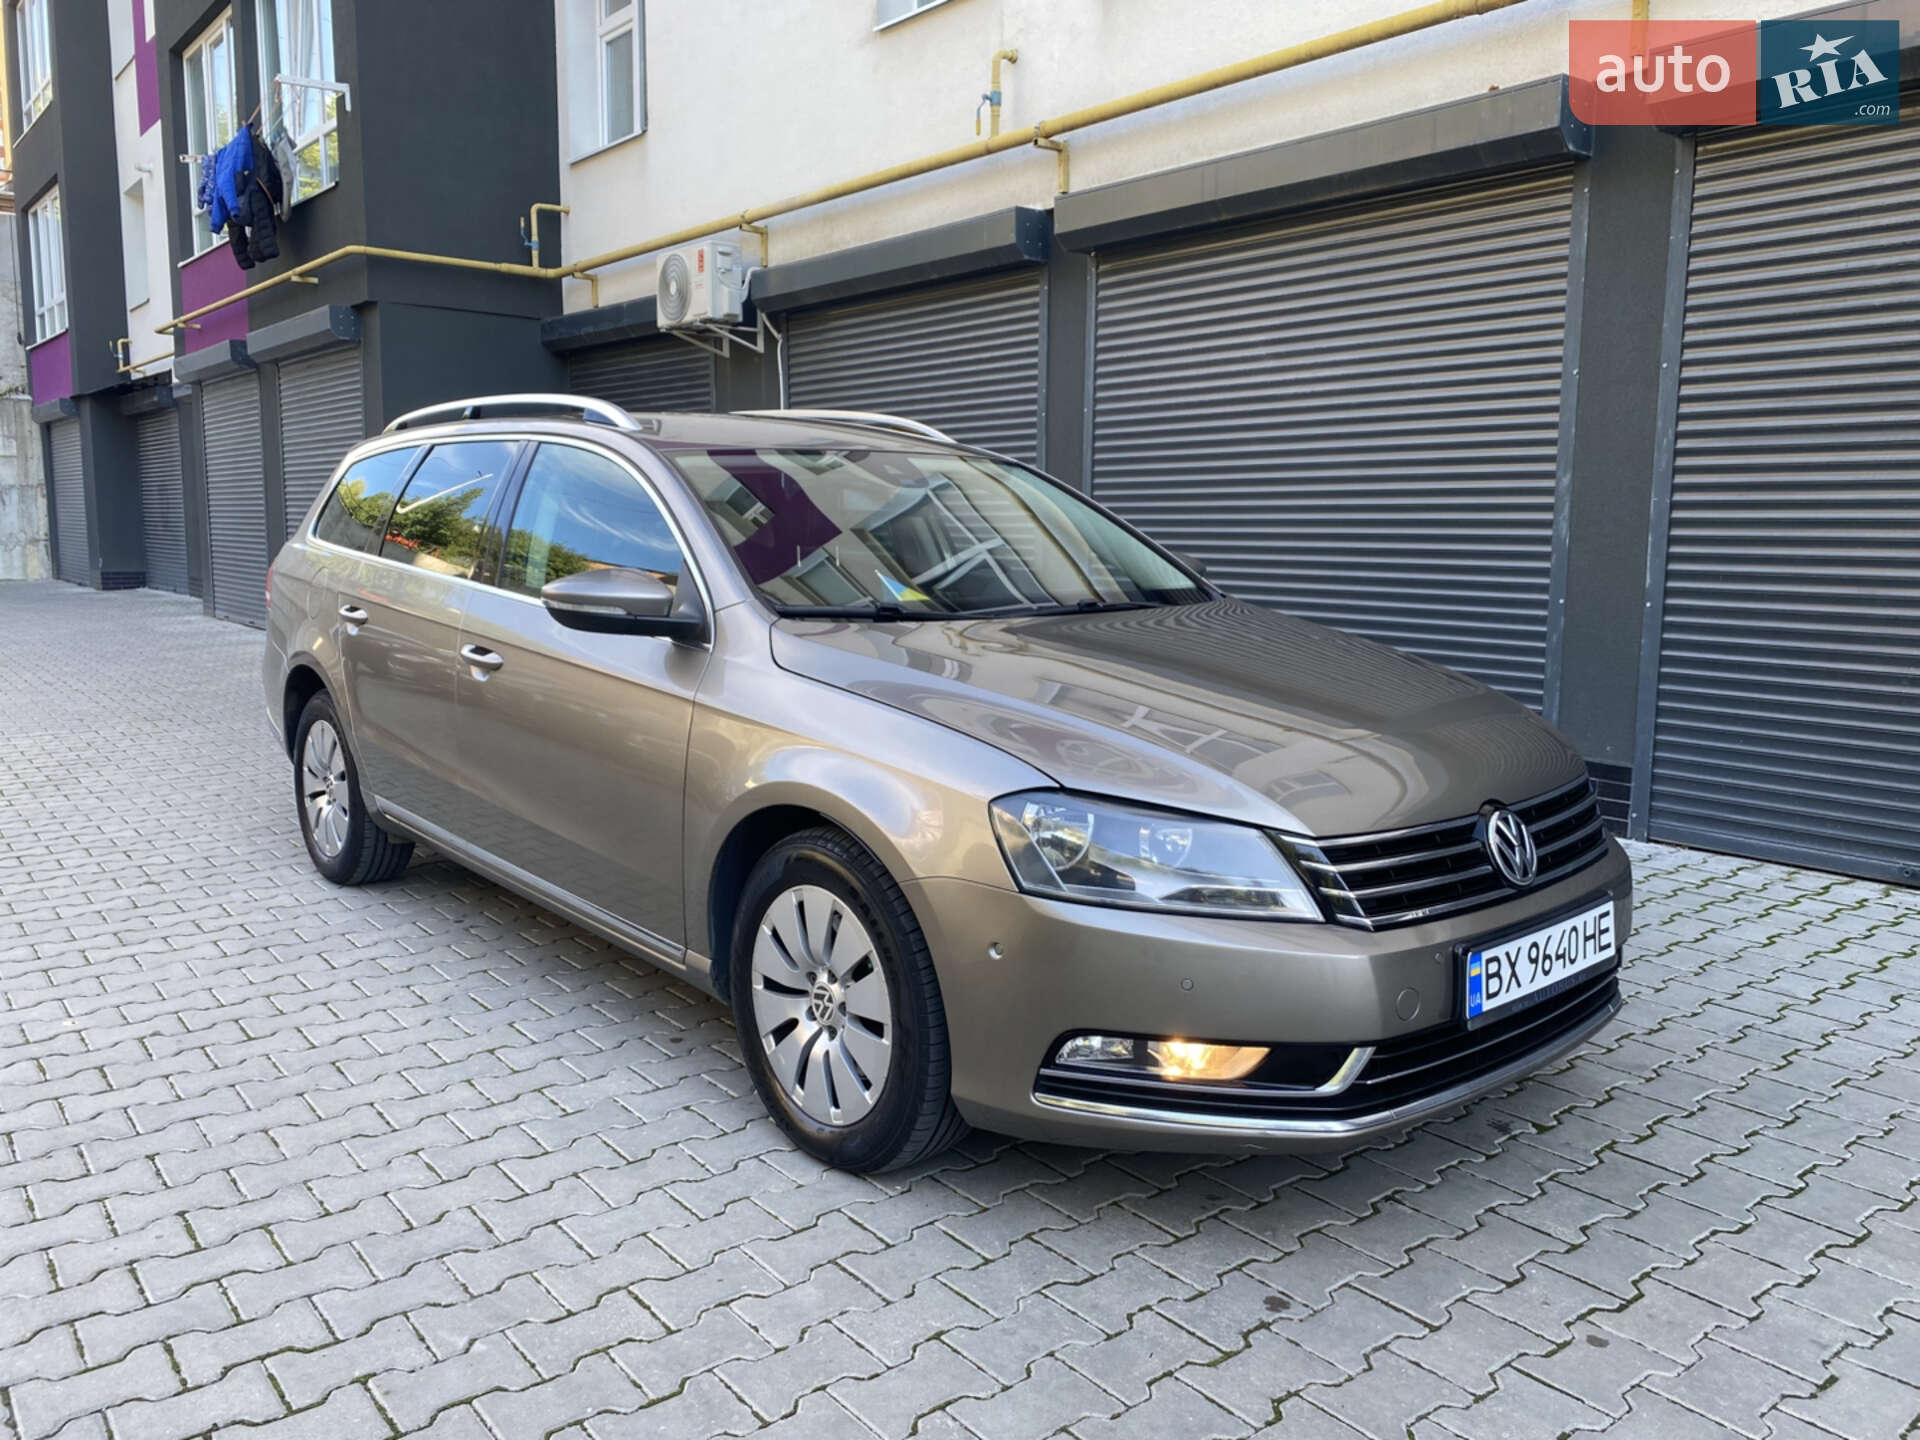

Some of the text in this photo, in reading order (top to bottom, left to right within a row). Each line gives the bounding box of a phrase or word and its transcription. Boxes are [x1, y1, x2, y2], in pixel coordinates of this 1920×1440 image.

[1485, 947, 1522, 1001] BX
[1527, 925, 1579, 984] 9640
[1583, 910, 1612, 960] HE
[1470, 992, 1481, 1008] UA
